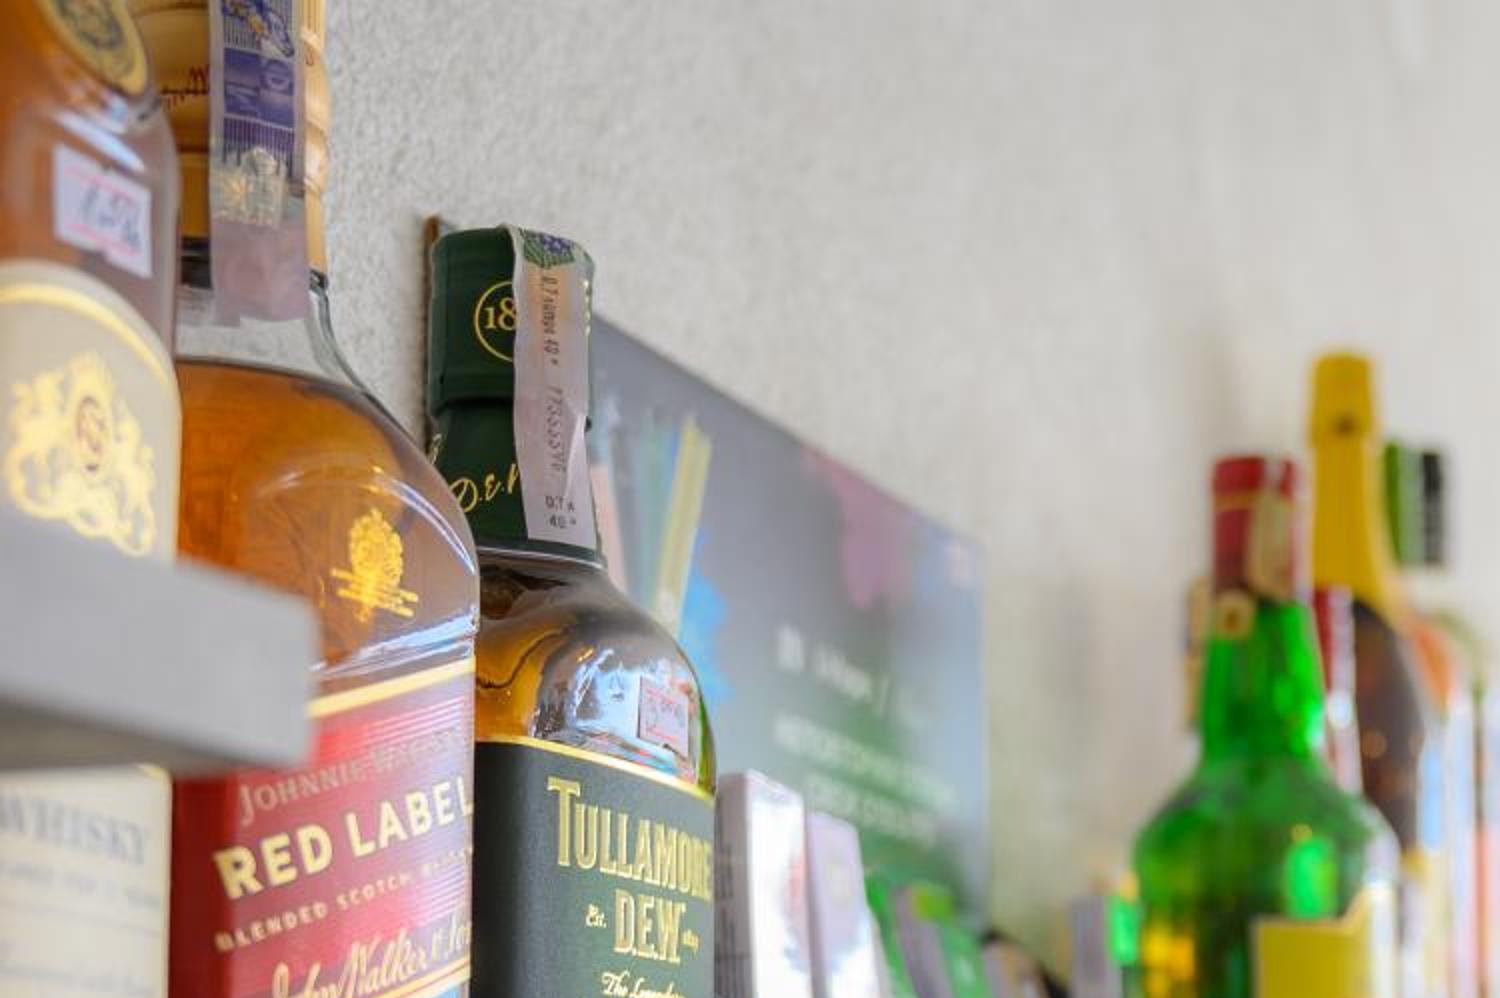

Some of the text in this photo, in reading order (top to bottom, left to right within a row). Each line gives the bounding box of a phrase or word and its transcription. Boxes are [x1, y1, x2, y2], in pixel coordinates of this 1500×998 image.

[484, 297, 517, 331] 18
[213, 823, 334, 901] RED
[345, 776, 475, 858] LABEL
[214, 901, 329, 953] BLENDED
